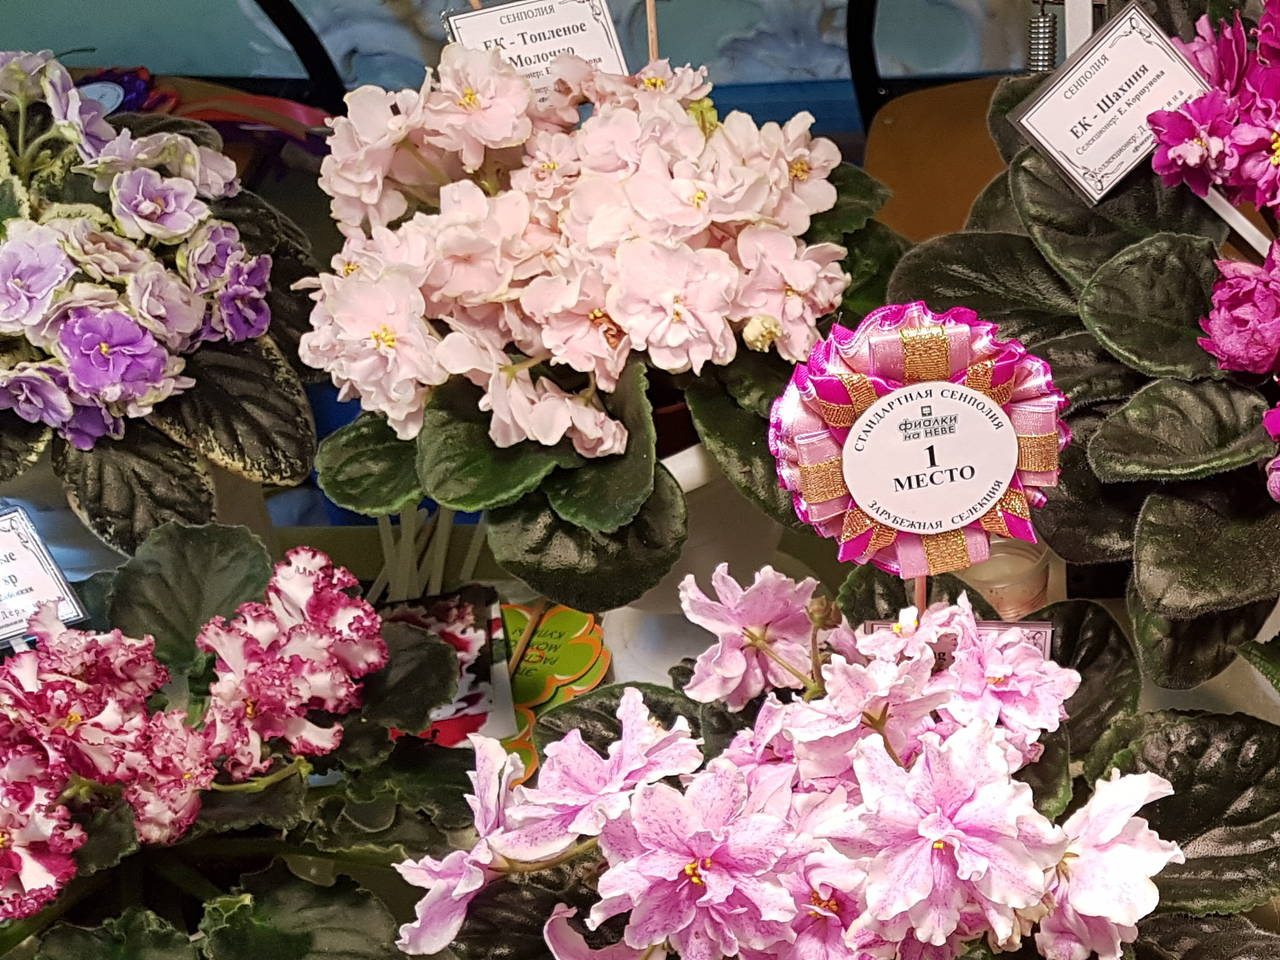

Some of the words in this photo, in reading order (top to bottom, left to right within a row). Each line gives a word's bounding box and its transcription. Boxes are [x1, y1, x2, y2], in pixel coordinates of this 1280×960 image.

[500, 4, 556, 25] СЕНПОЛИЯ
[517, 21, 587, 47] Топленое
[1063, 53, 1110, 100] СЕНПОЛИЯ
[1125, 69, 1166, 109] Коршунова
[1069, 115, 1093, 140] ЕК
[1096, 64, 1150, 115] Шахиня
[854, 389, 933, 452] СТАНДАРТНАЯ
[940, 389, 1004, 431] СЕНПОЛИЯ
[898, 414, 959, 432] фиалки
[904, 430, 922, 441] на
[924, 424, 956, 438] НЕВЕ
[924, 445, 941, 469] 1
[893, 464, 976, 493] МЕСТО
[867, 500, 943, 530] ЗАРУБЕЖНАЯ
[951, 479, 1004, 526] СЕЛЕКЦИЯ
